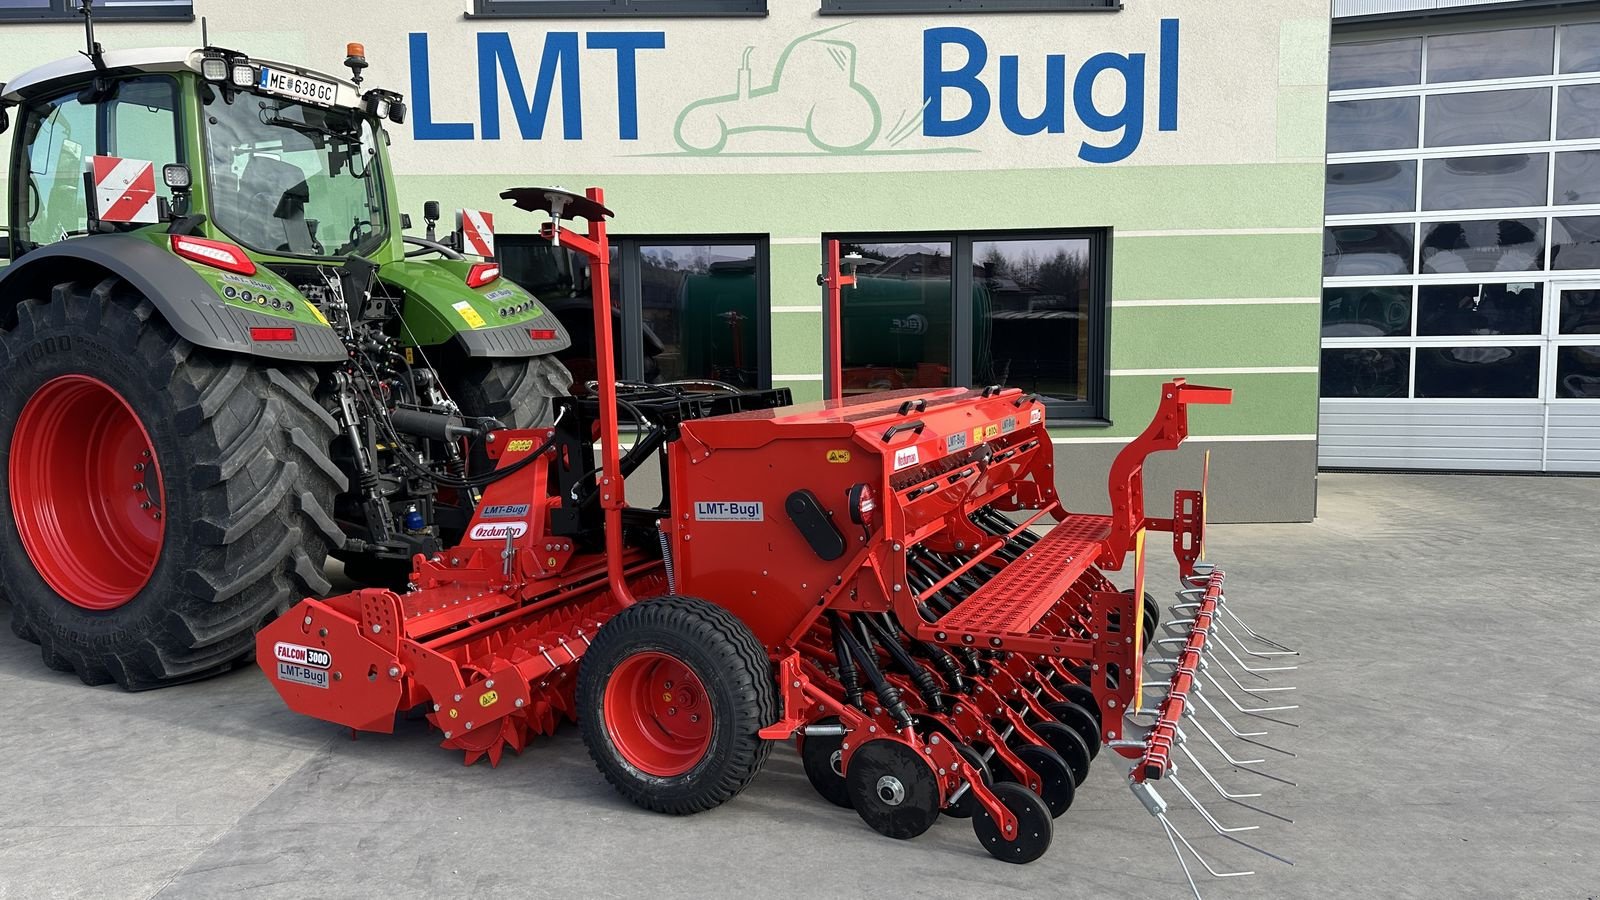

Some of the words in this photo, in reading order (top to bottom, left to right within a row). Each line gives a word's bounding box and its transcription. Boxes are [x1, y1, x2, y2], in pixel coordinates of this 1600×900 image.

[269, 73, 286, 90] ME
[294, 79, 316, 97] 638
[317, 85, 332, 101] GC
[408, 31, 665, 140] LMT
[923, 18, 1179, 163] Bugl
[484, 504, 528, 515] LMT-Bugl
[698, 503, 760, 517] LMT-Bugl
[278, 645, 306, 661] FALCON
[308, 651, 328, 665] 3000
[280, 663, 326, 684] LMT-Bugl
